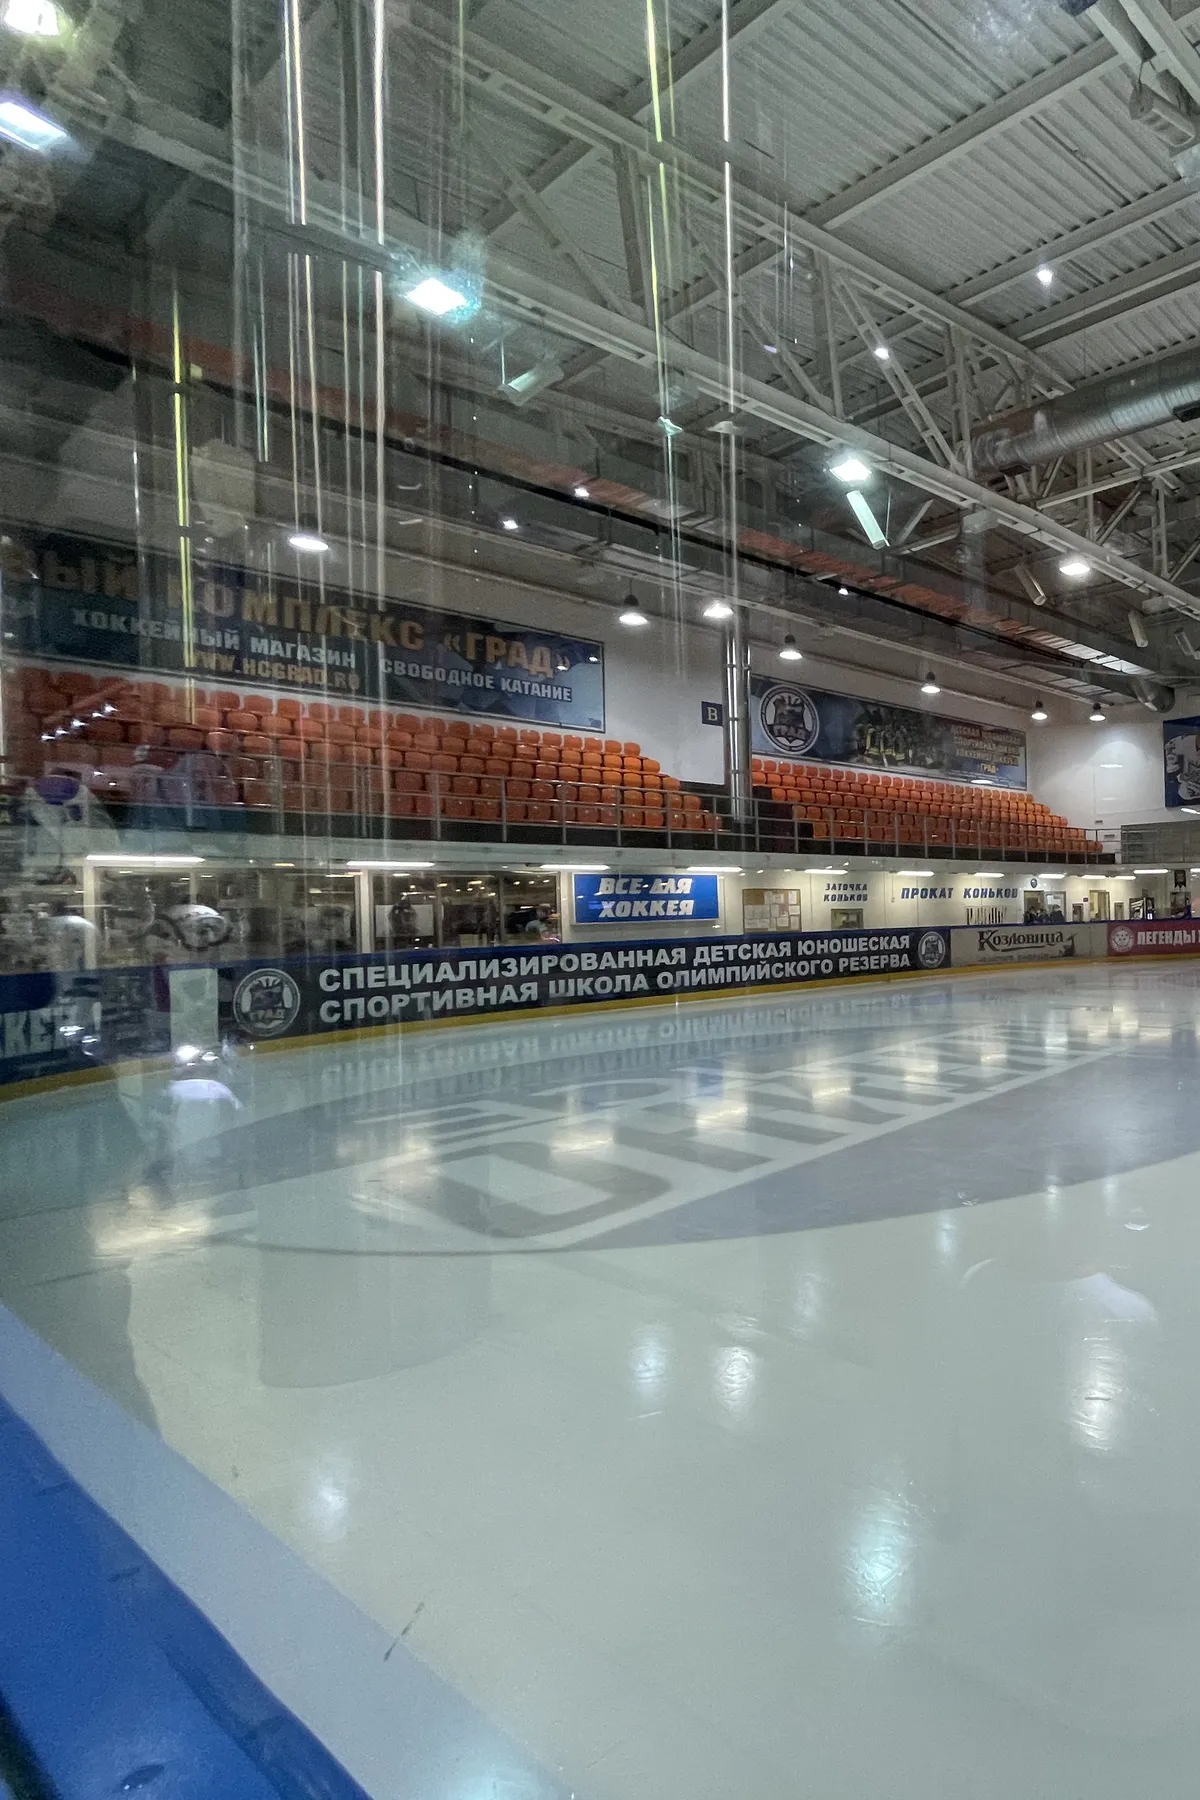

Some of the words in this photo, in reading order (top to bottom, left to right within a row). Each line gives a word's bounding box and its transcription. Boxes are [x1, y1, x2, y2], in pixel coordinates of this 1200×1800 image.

[250, 634, 356, 669] МАГАЗИН
[381, 657, 495, 691] СВОБОДНОЕ
[501, 677, 572, 702] КАТАНИЕ
[599, 877, 643, 895] ВСЕ
[649, 878, 693, 894] ДЛЯ
[825, 883, 868, 892] ЗАТОЧКА
[901, 887, 955, 900] ПРОКАТ
[963, 887, 1019, 900] КОНЬКОВ
[824, 893, 868, 902] КОНЬКОВ
[599, 899, 695, 918] ХОККЕЯ
[977, 929, 1064, 952] Козловица
[1137, 929, 1196, 946] ЛЕГЕНДЫ
[319, 946, 685, 993] СПЕЦИАЛИЗИРОВАННАЯ
[693, 938, 793, 968] ДЕТСКАЯ
[797, 934, 910, 957] ЮНОШЕСКАЯ
[319, 980, 539, 1024] СПОРТИВНАЯ
[548, 972, 648, 999] ШКОЛА
[657, 957, 832, 989] ОЛИМПИЙСКОГО
[837, 951, 911, 974] РЕЗЕРВА
